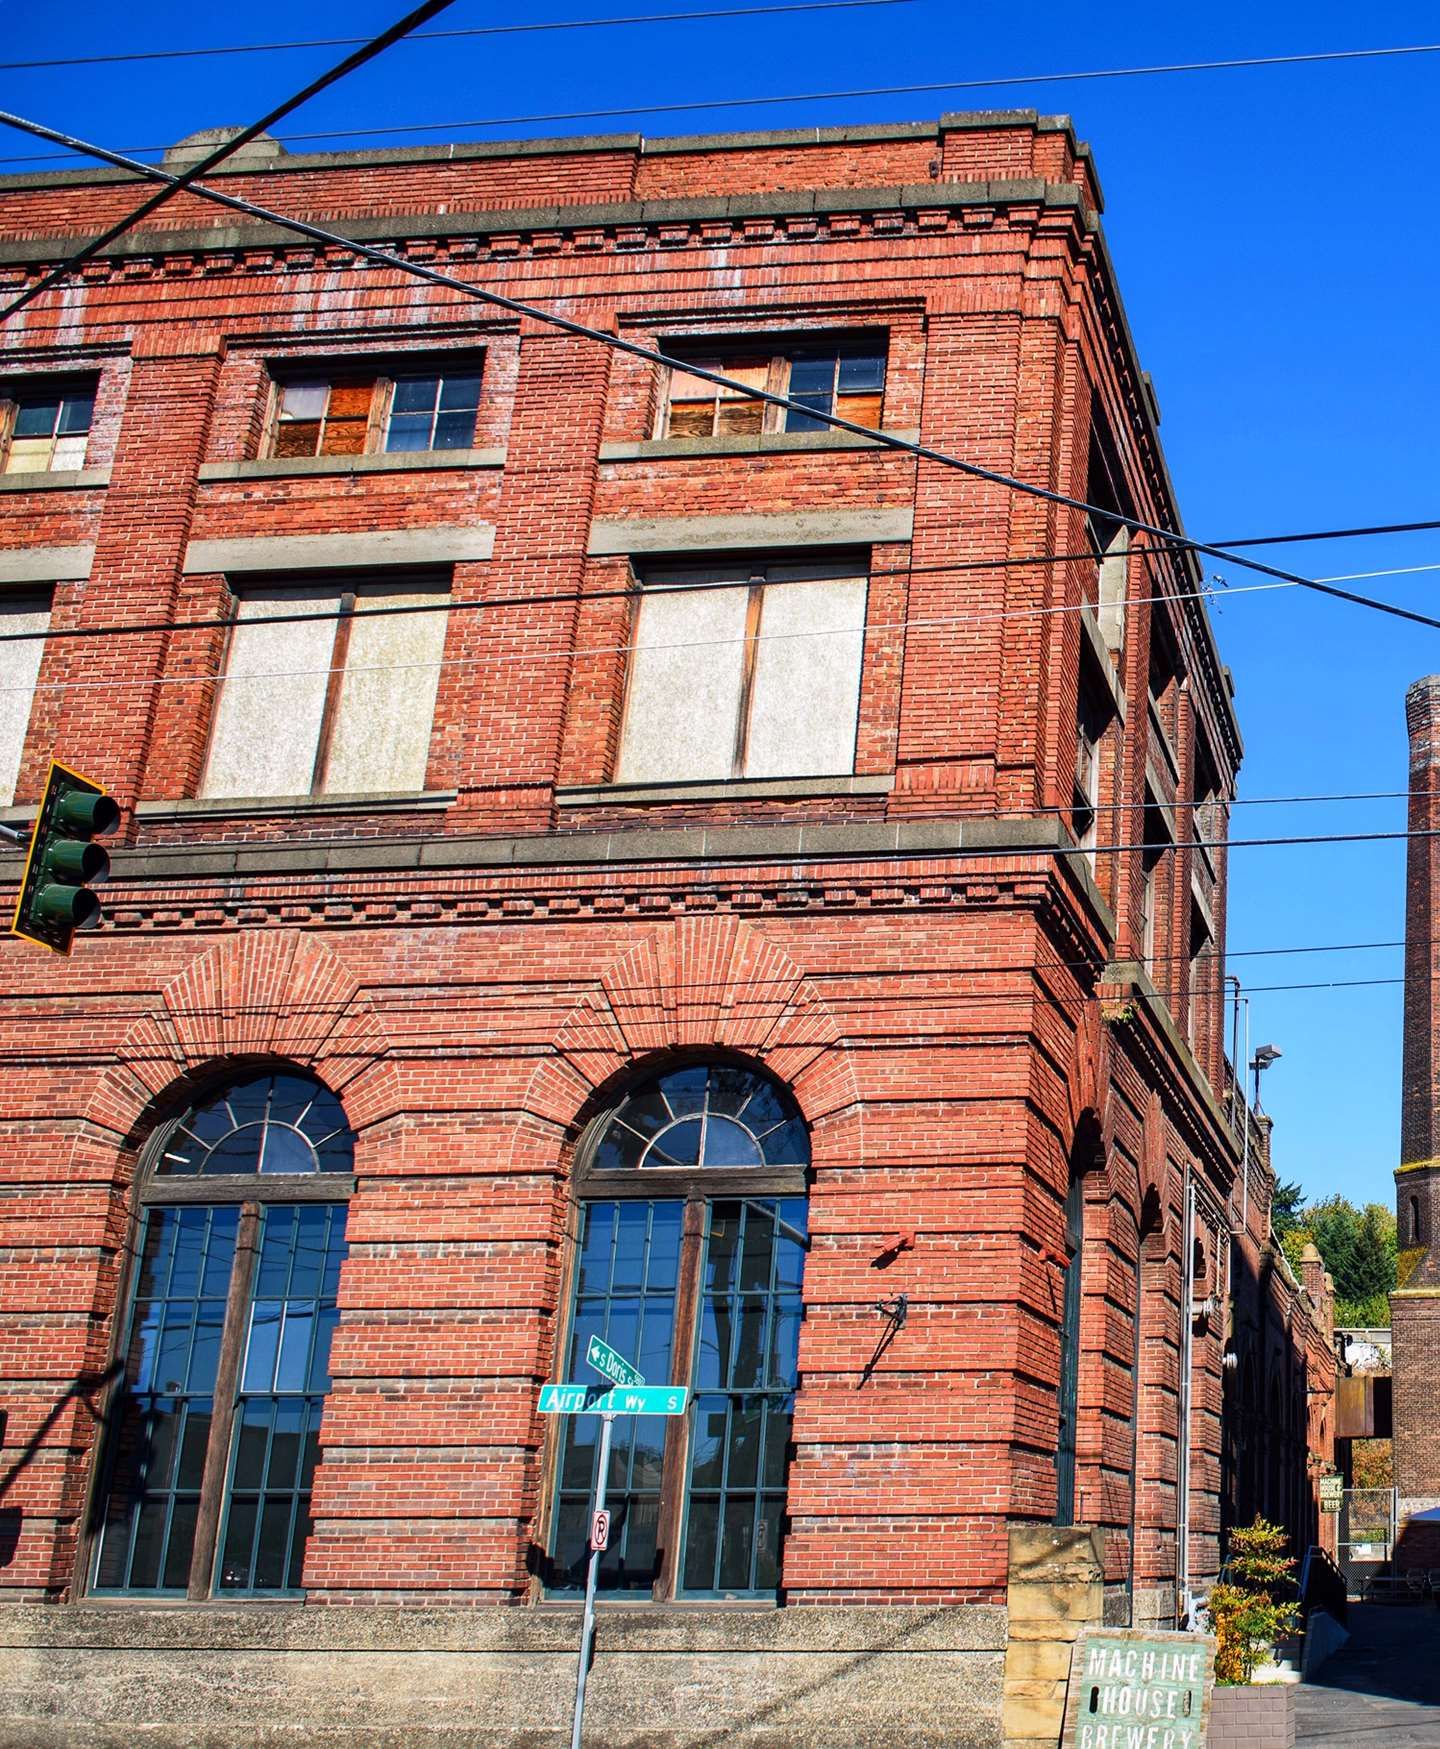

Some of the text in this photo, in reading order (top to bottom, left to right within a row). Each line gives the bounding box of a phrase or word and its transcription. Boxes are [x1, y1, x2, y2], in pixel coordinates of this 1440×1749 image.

[606, 1351, 627, 1384] Doris
[545, 1388, 678, 1411] Airport Wy S
[1324, 1500, 1340, 1509] BEER
[1088, 1647, 1201, 1682] MACHINE
[1102, 1685, 1179, 1719] HOUSE
